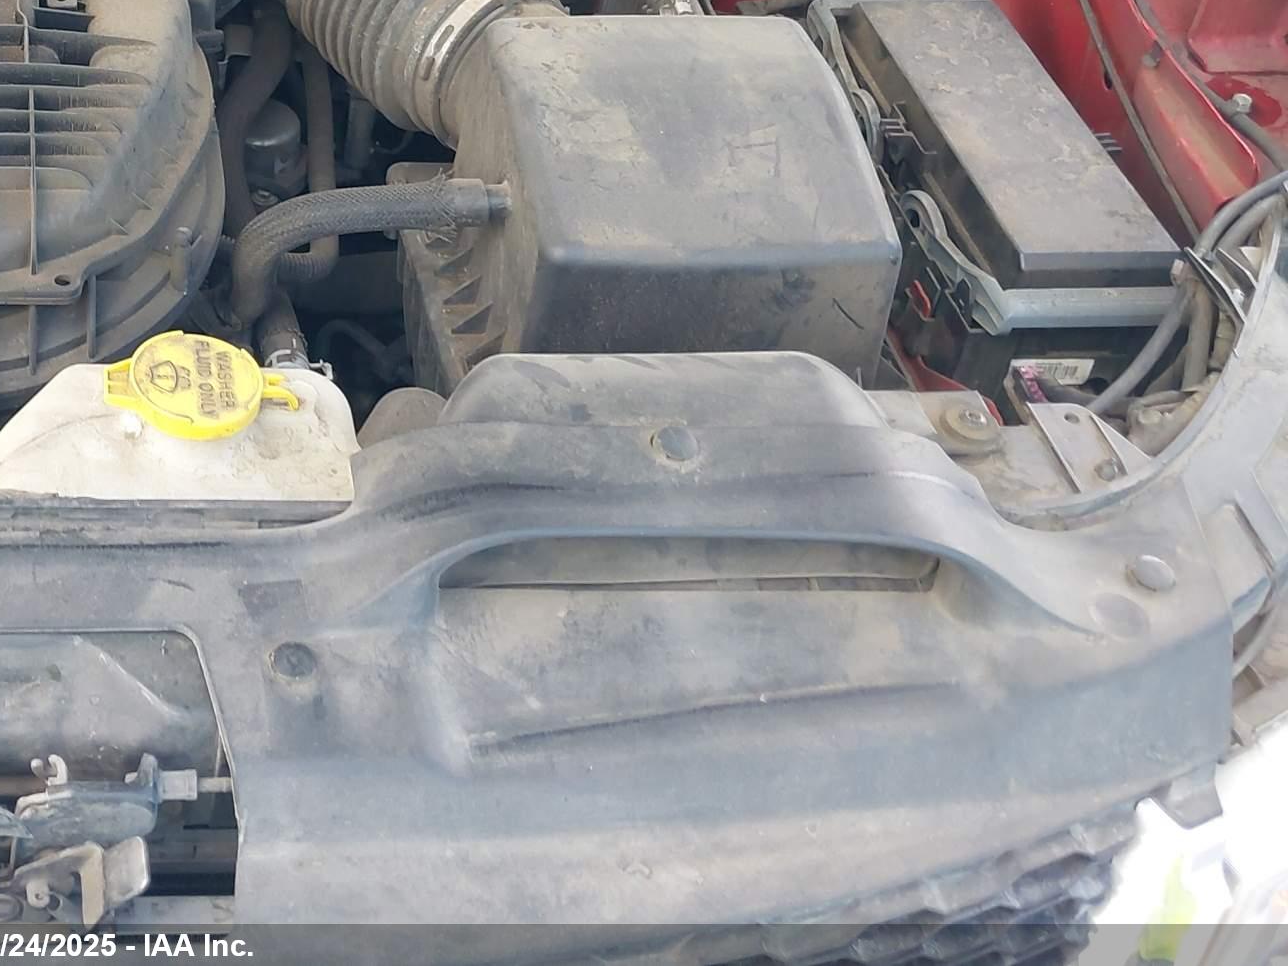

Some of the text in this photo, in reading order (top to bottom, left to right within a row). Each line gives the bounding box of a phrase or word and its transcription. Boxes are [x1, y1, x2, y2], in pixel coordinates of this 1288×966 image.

[194, 339, 219, 419] FLUID ONLY
[215, 350, 236, 411] WASHER
